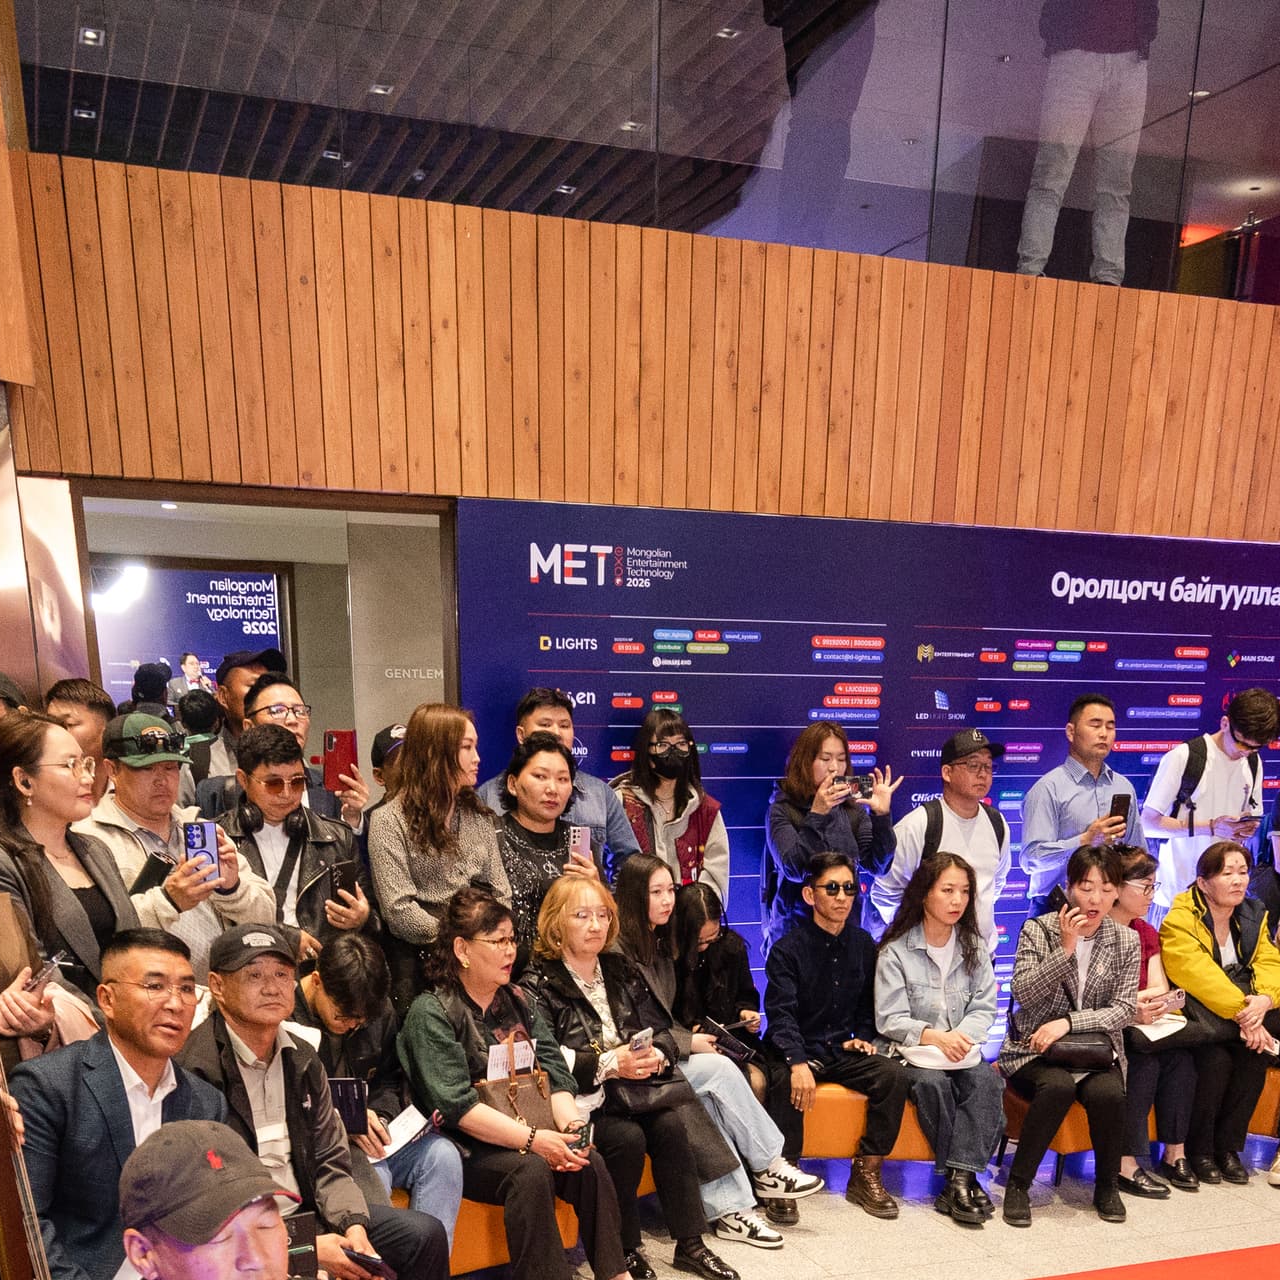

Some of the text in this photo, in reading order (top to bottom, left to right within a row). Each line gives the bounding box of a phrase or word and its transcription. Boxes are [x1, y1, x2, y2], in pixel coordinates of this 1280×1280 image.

[626, 547, 672, 559] Mongolian
[530, 542, 613, 586] MET
[626, 558, 687, 569] Entertainment
[626, 568, 675, 580] Technology
[626, 578, 651, 588] 2026
[1050, 570, 1166, 604] Оролцогч
[555, 637, 598, 650] LIGHTS
[385, 668, 444, 680] GENTLEM
